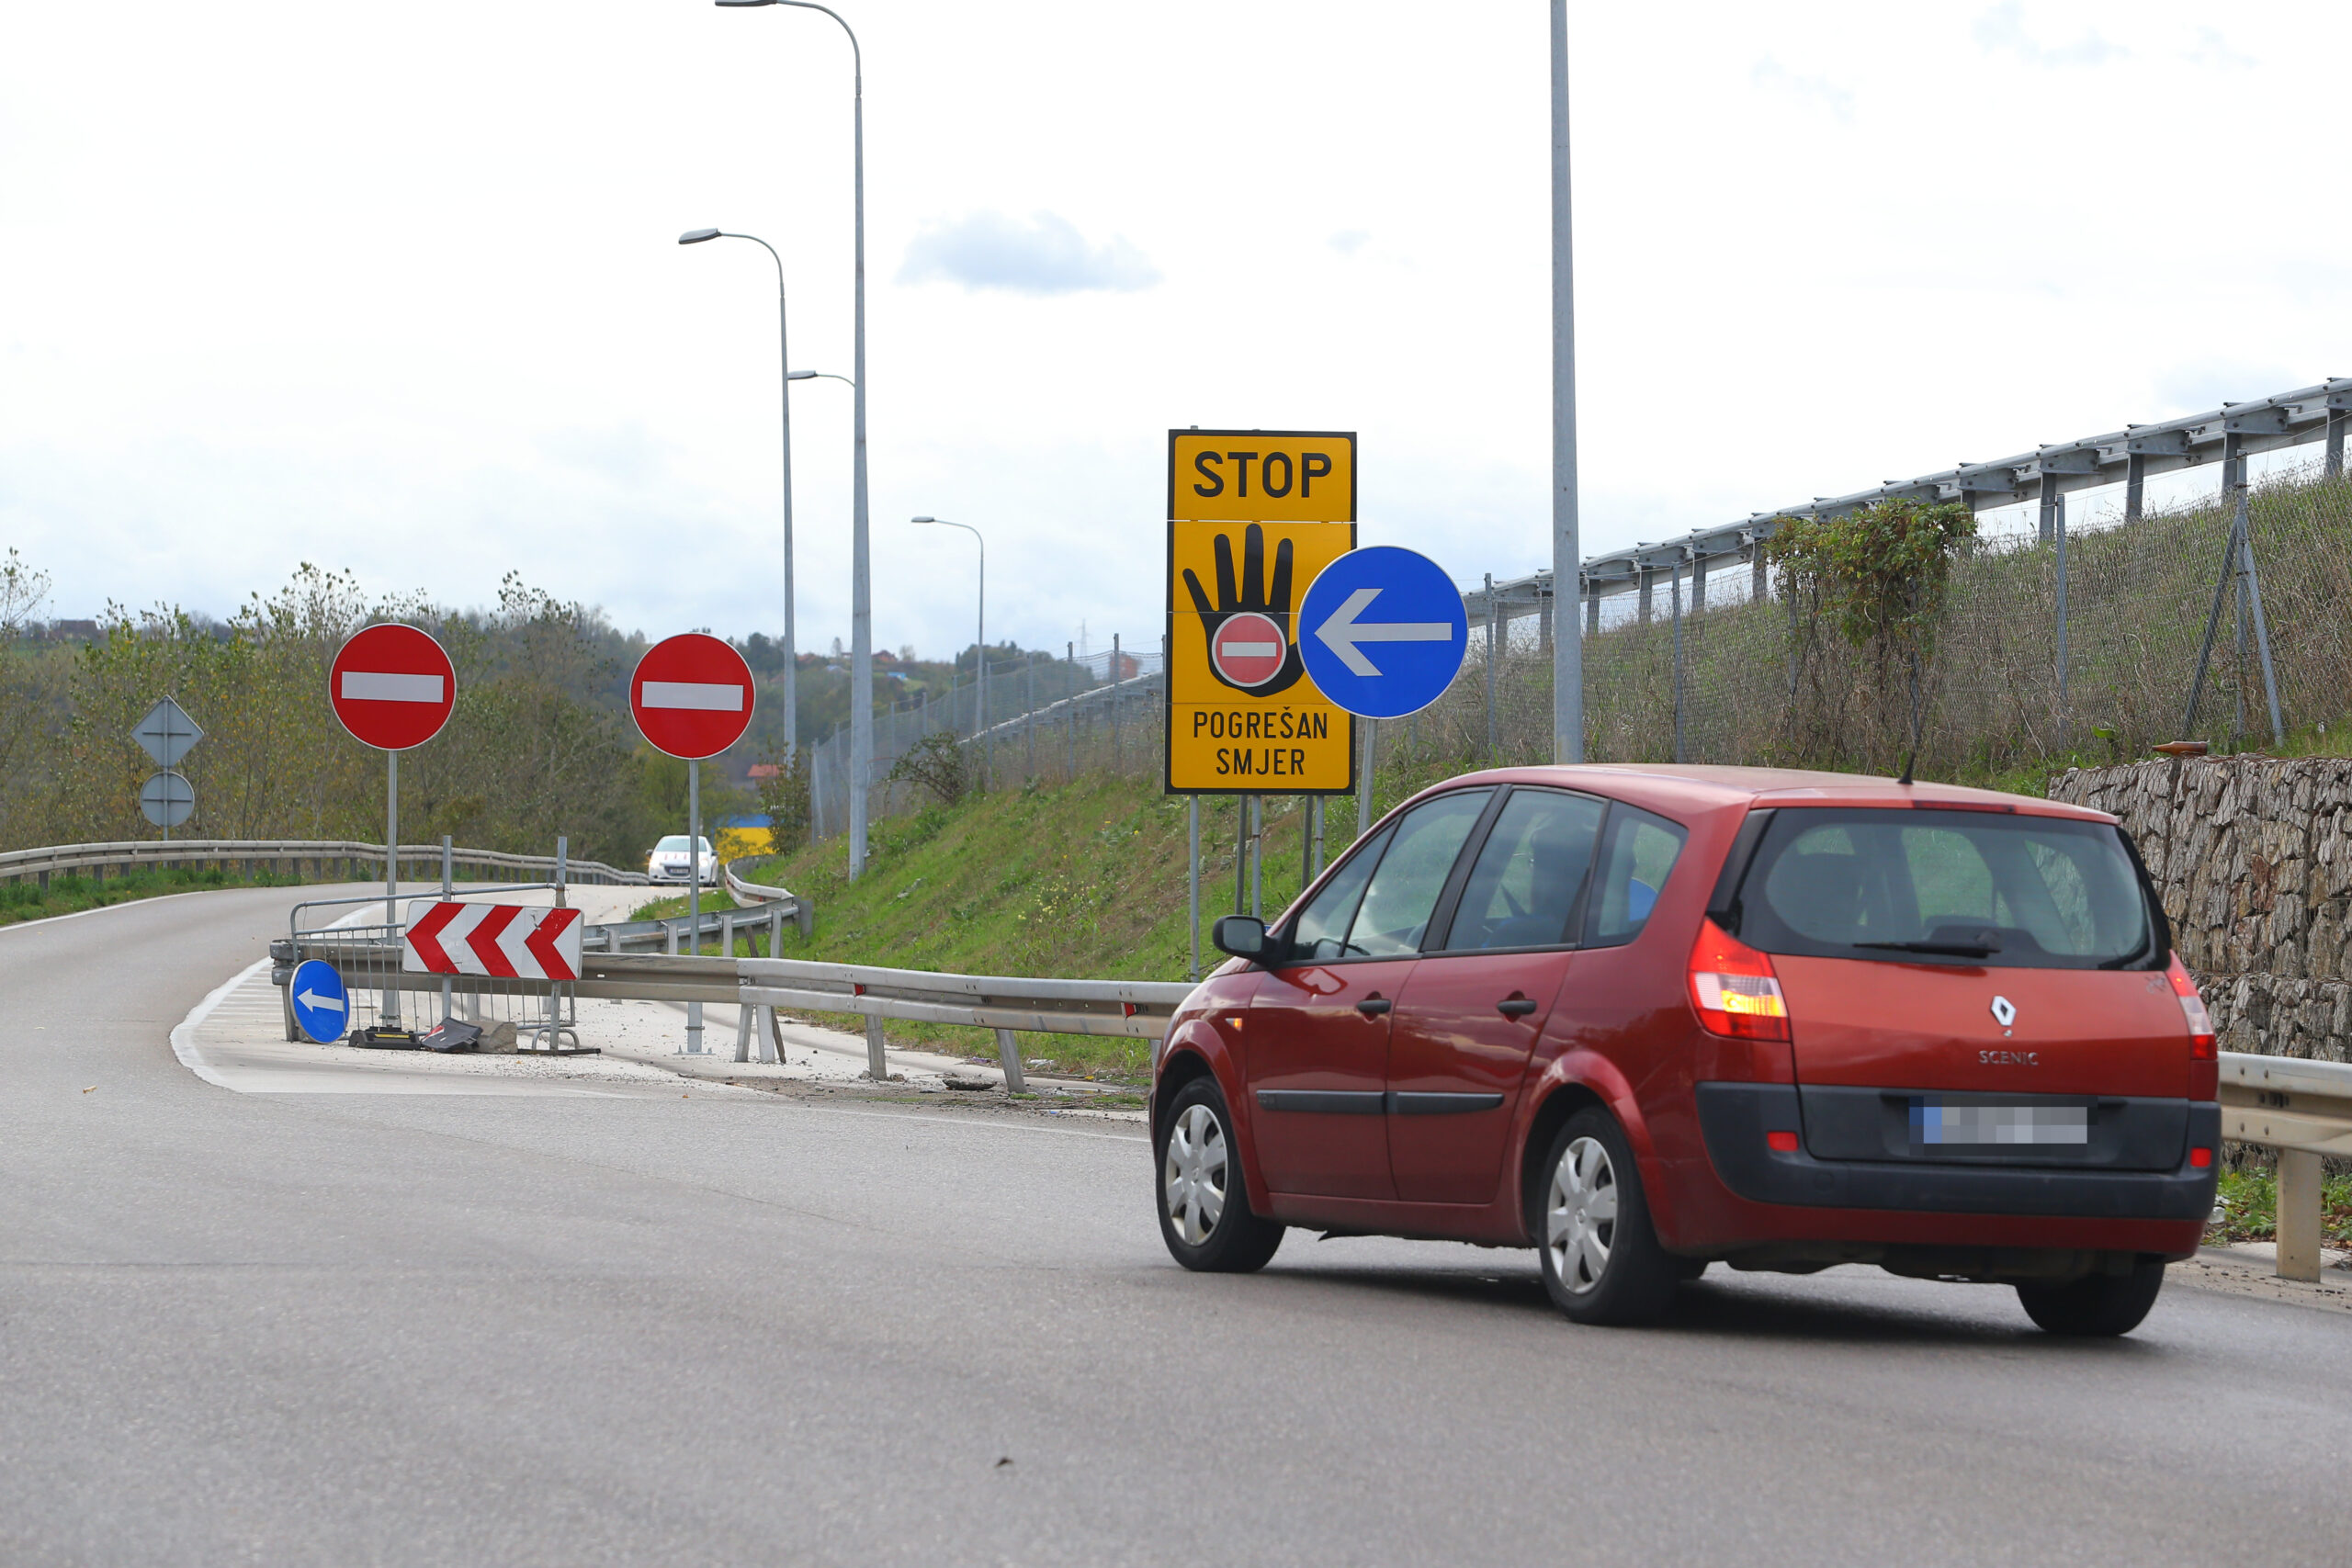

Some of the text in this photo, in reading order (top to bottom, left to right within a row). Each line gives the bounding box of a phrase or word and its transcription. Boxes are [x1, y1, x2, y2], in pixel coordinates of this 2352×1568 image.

[1193, 451, 1332, 498] STOP
[1193, 706, 1328, 739] POGREŠAN
[1216, 749, 1306, 775] SMJER
[1978, 1050, 2039, 1066] SCENIC
